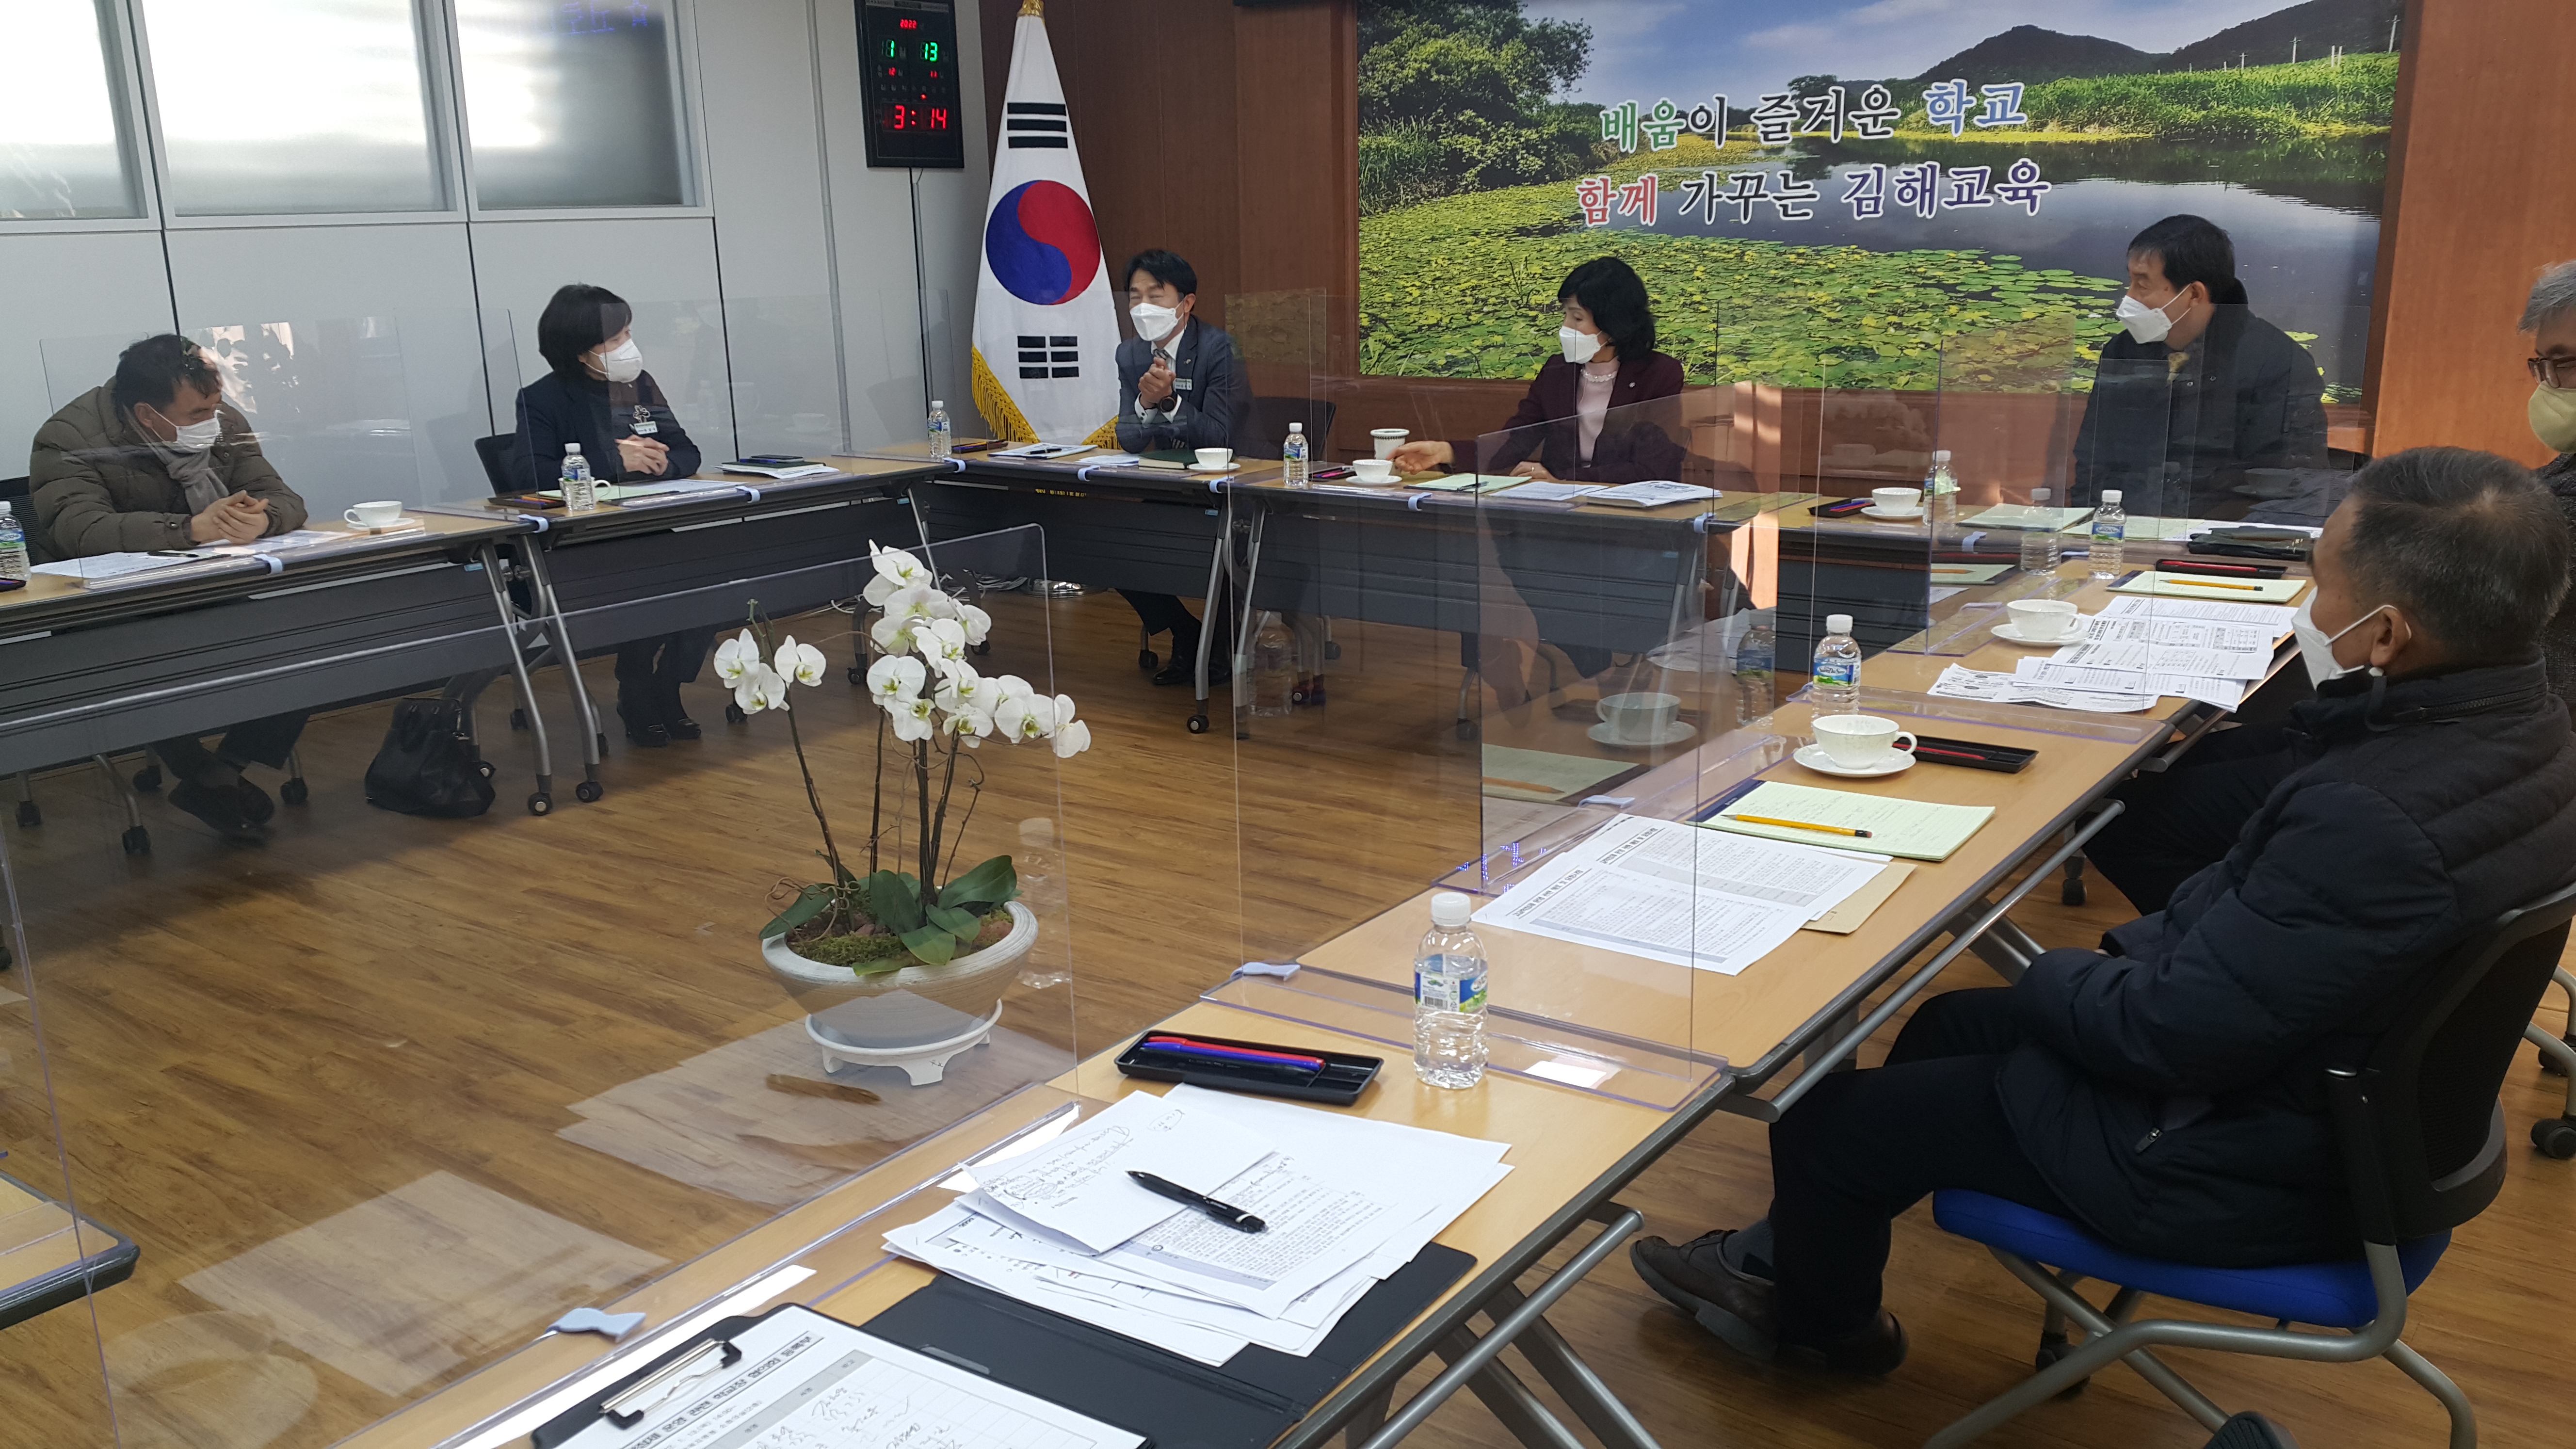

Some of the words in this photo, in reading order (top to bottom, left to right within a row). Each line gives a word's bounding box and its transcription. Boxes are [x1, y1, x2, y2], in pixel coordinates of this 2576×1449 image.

[900, 19, 917, 29] 2022
[924, 42, 938, 62] 13
[894, 105, 947, 129] 3:14
[1601, 95, 1728, 153] 배움이
[1751, 84, 1901, 144] 즐거운
[1923, 79, 2028, 137] 학교
[1577, 175, 1658, 227] 함께
[1679, 170, 1819, 225] 가꾸는
[1842, 158, 2052, 220] 김해교육
